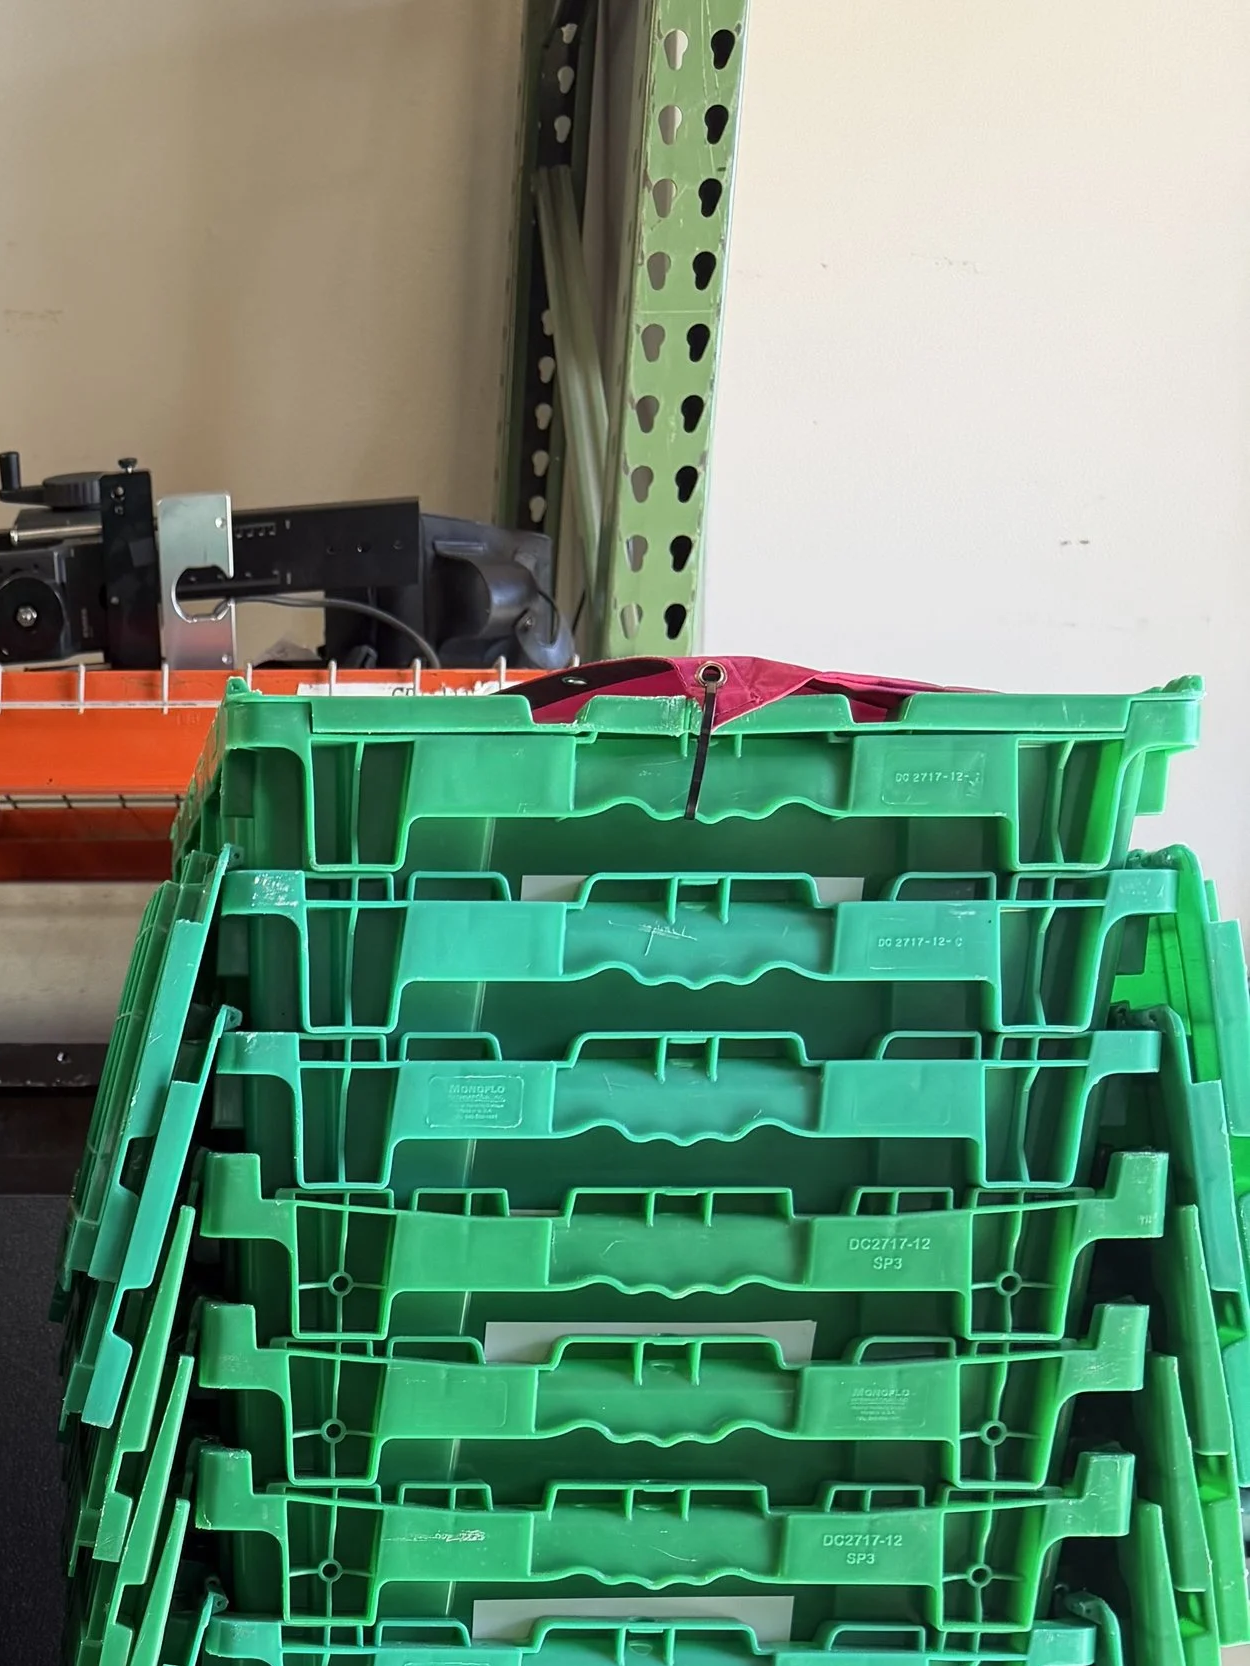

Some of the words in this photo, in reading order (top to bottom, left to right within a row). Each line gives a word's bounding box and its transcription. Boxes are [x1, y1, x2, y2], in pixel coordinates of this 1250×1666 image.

[878, 937, 892, 948] DC
[849, 1238, 931, 1251] DC2717-12
[872, 1256, 903, 1270] SP3
[823, 1534, 903, 1547] DC2717-12
[846, 1552, 875, 1565] SP3
